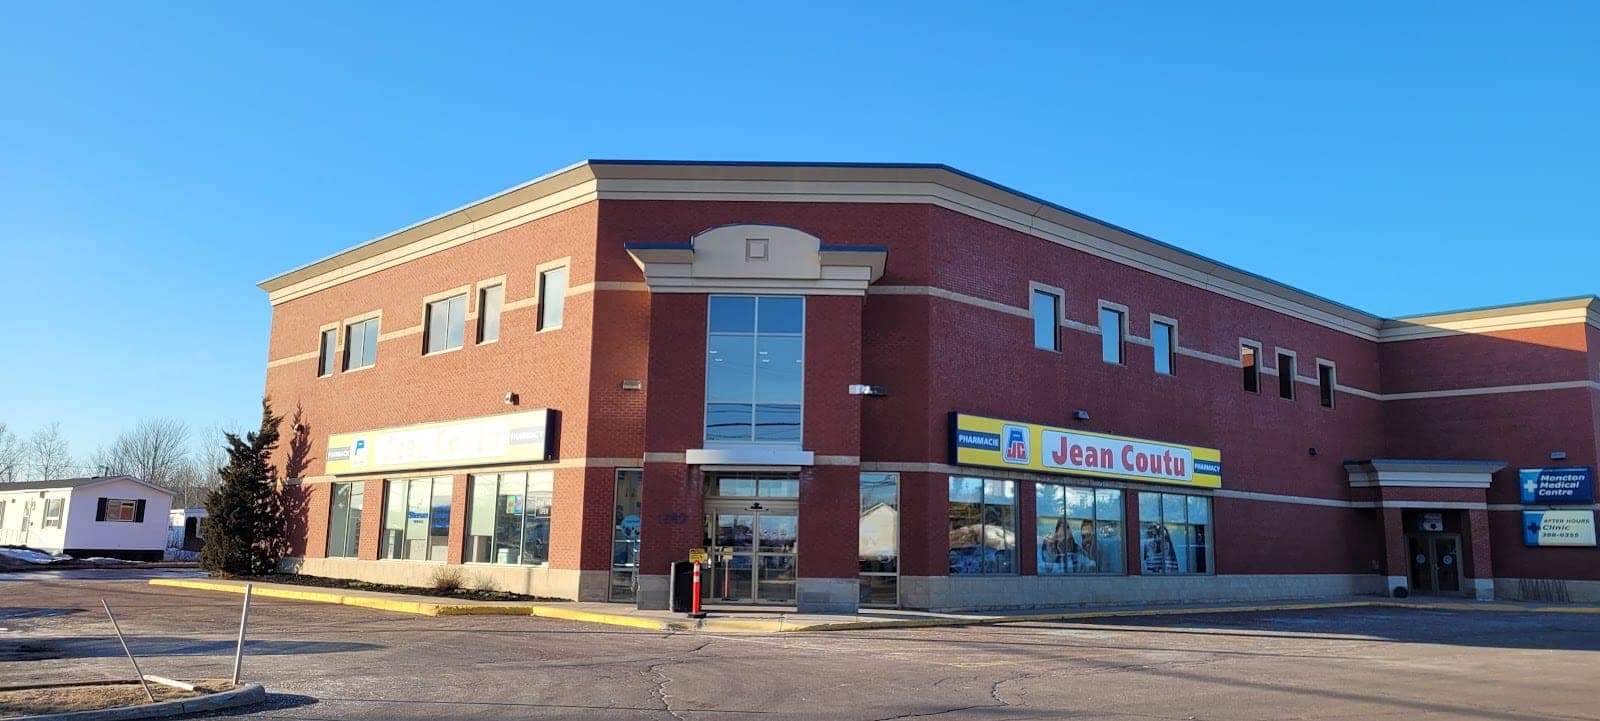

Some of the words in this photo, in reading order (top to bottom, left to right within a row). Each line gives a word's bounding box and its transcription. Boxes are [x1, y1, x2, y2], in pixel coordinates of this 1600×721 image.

[958, 433, 999, 447] PHARMACIE
[1052, 436, 1114, 469] Jean
[1121, 444, 1185, 477] Coutu
[1194, 460, 1221, 473] PHARMACY
[1541, 474, 1585, 482] Moncton
[1540, 481, 1579, 489] Medical
